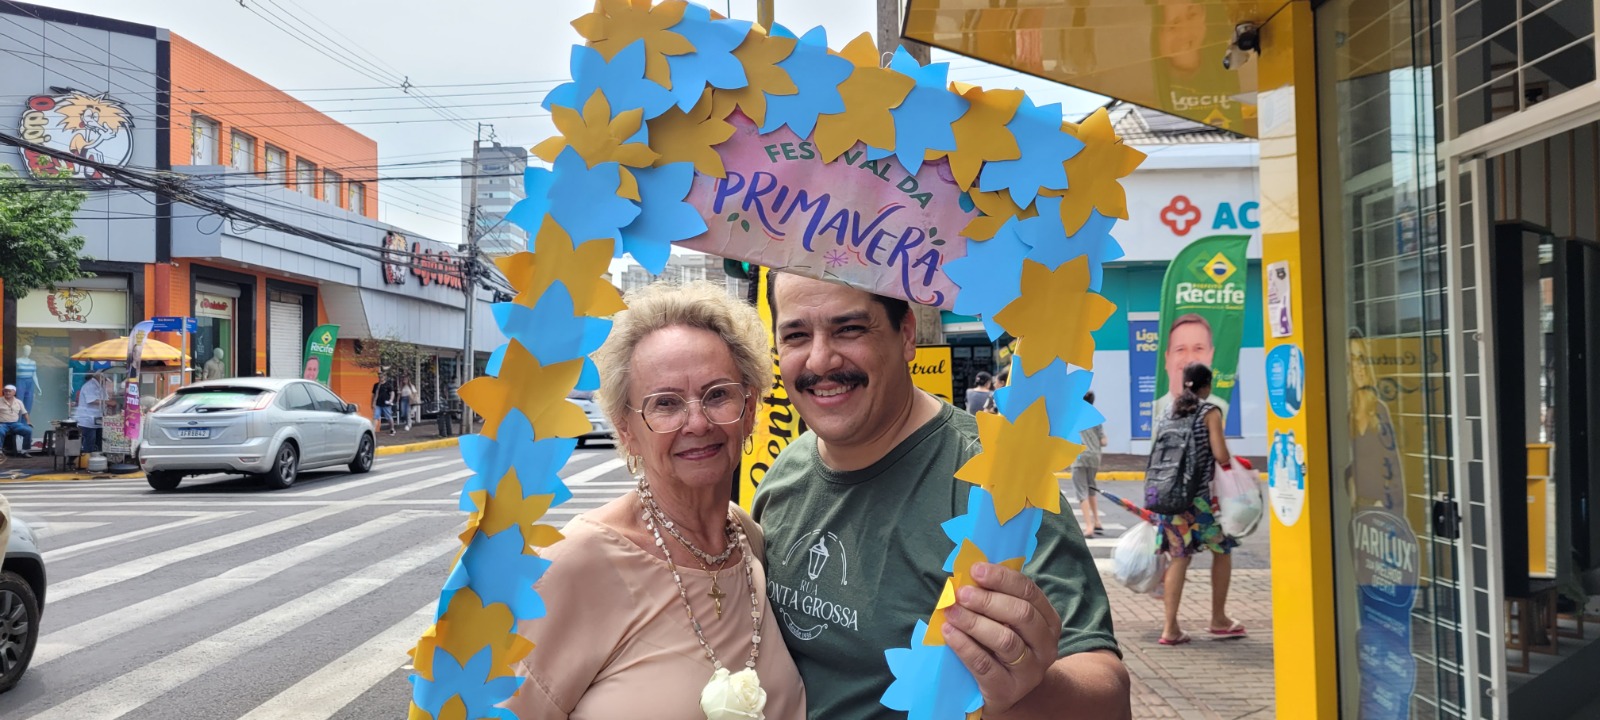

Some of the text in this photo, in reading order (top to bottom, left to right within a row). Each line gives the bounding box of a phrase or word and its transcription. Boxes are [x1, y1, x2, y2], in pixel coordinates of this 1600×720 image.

[764, 141, 934, 209] FESVAL DA
[713, 171, 944, 307] PRIMAVERA
[1175, 282, 1245, 305] Recife
[310, 341, 334, 354] Recife
[1353, 522, 1413, 573] VARILUX
[767, 580, 859, 631] ONTA GROSSA
[800, 579, 819, 596] RUA
